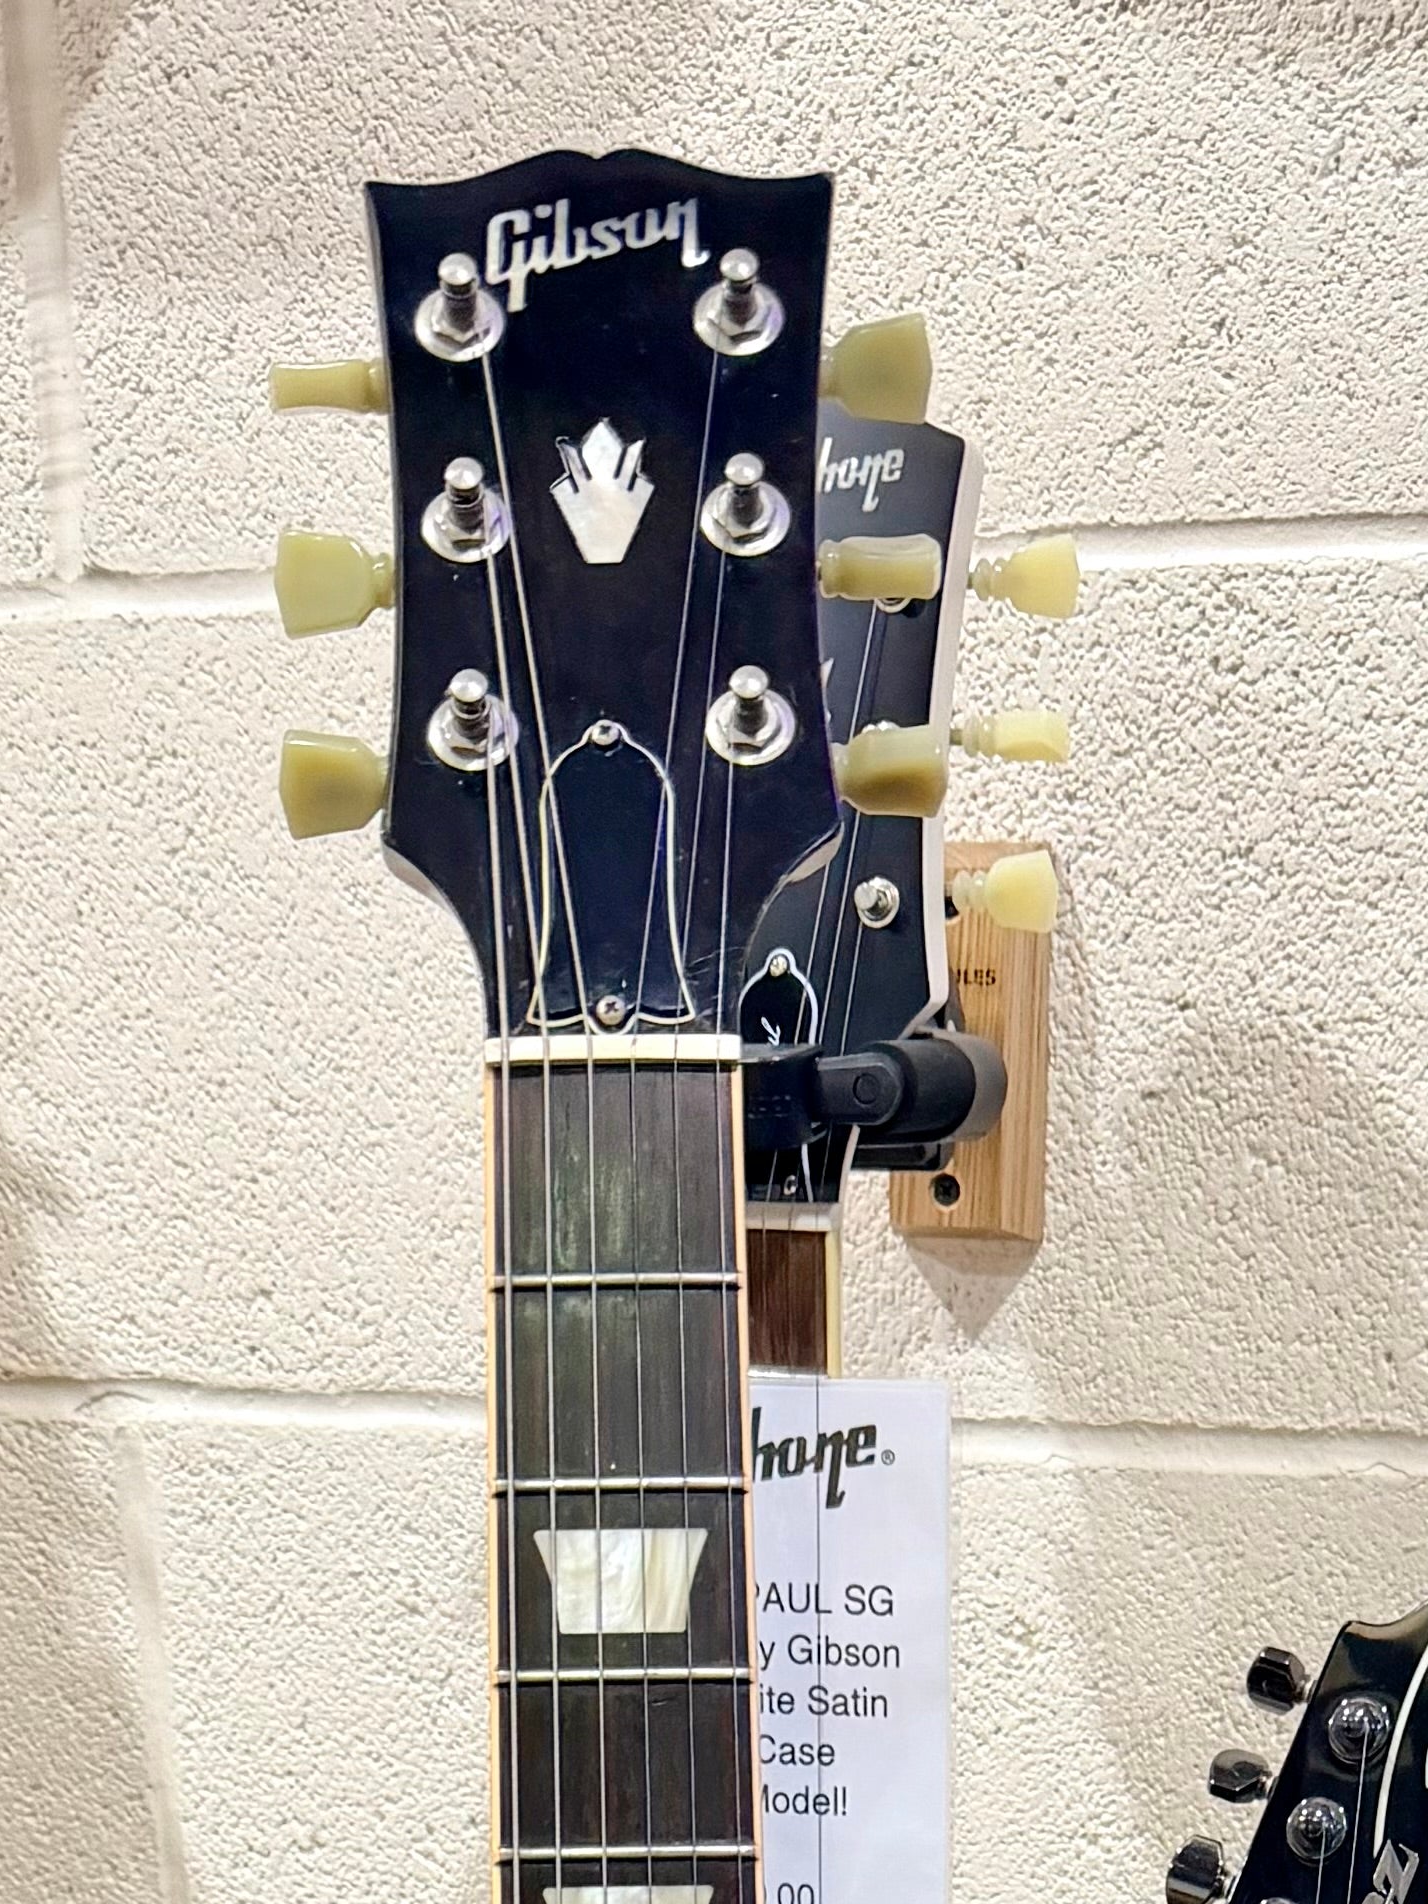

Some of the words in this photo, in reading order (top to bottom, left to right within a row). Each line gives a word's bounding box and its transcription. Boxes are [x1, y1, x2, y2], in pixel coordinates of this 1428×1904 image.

[484, 197, 710, 313] Gibson
[845, 1585, 894, 1617] SG
[788, 1634, 901, 1669] Gibson
[808, 1685, 889, 1718] Satin
